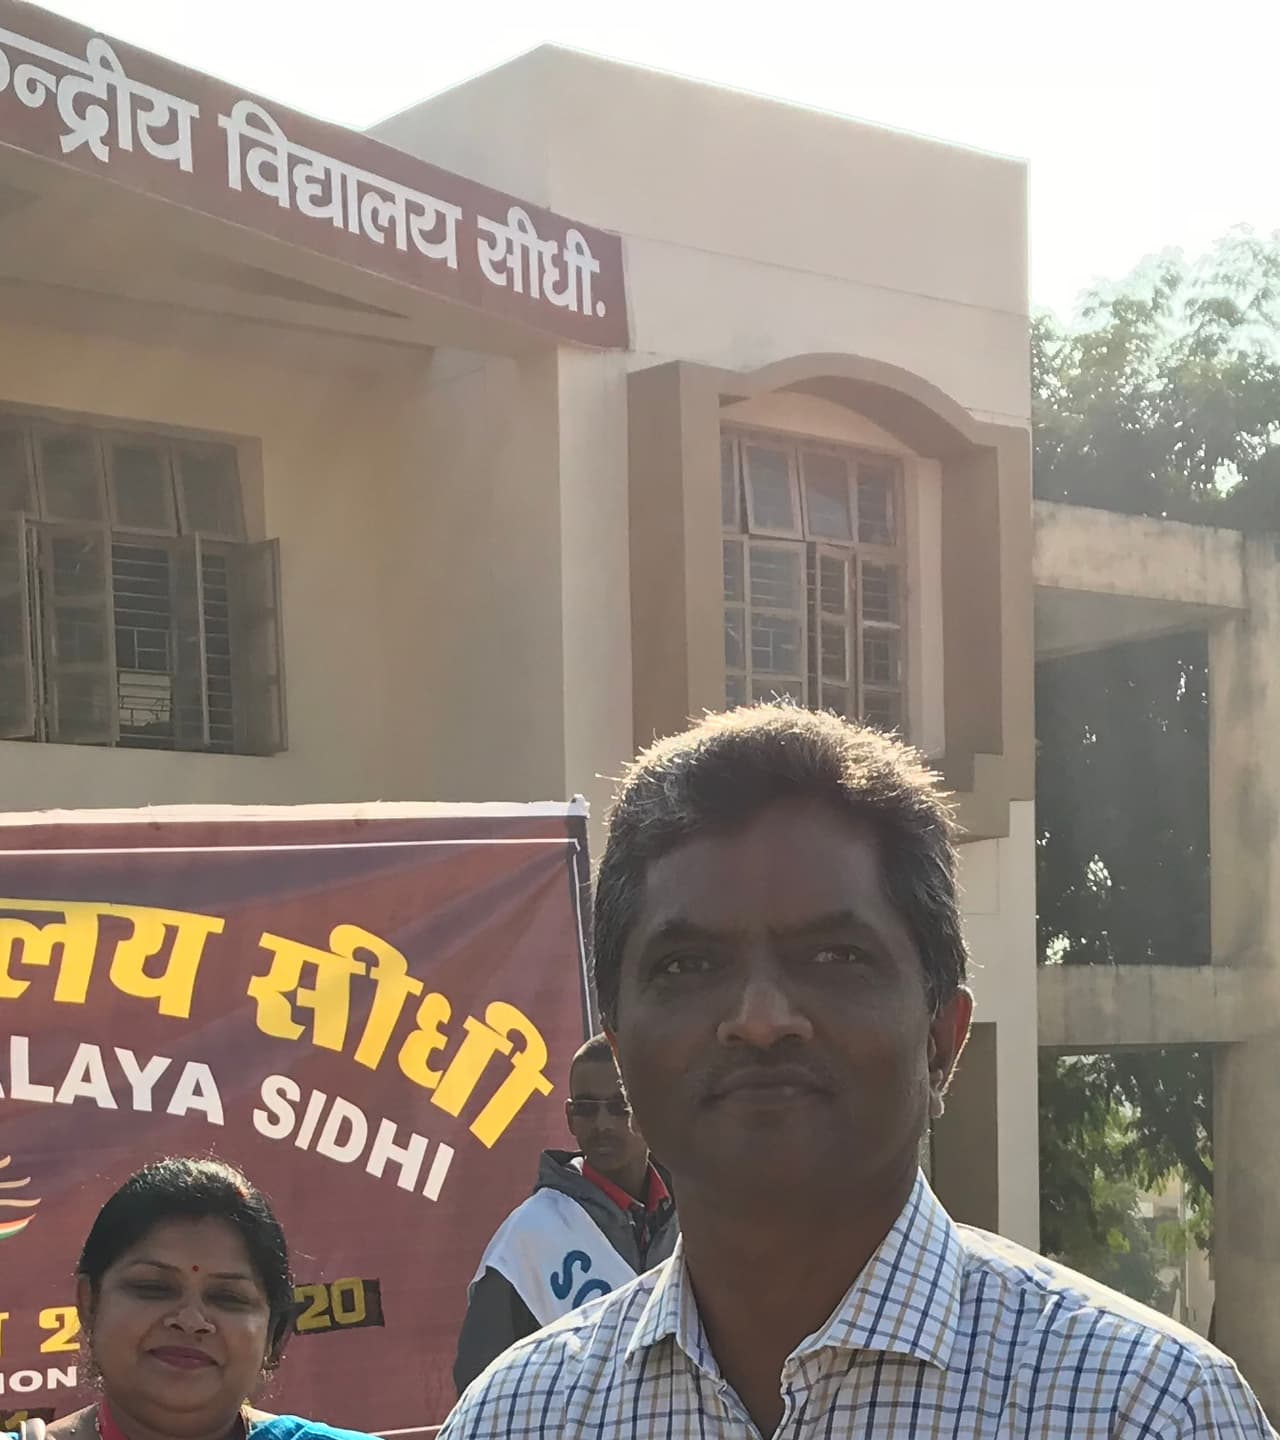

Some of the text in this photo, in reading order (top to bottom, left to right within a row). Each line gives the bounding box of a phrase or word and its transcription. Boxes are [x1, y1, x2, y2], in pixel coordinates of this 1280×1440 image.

[218, 100, 462, 269] विद्यालय
[247, 924, 554, 1149] सीधी
[253, 1075, 455, 1202] SIDHI
